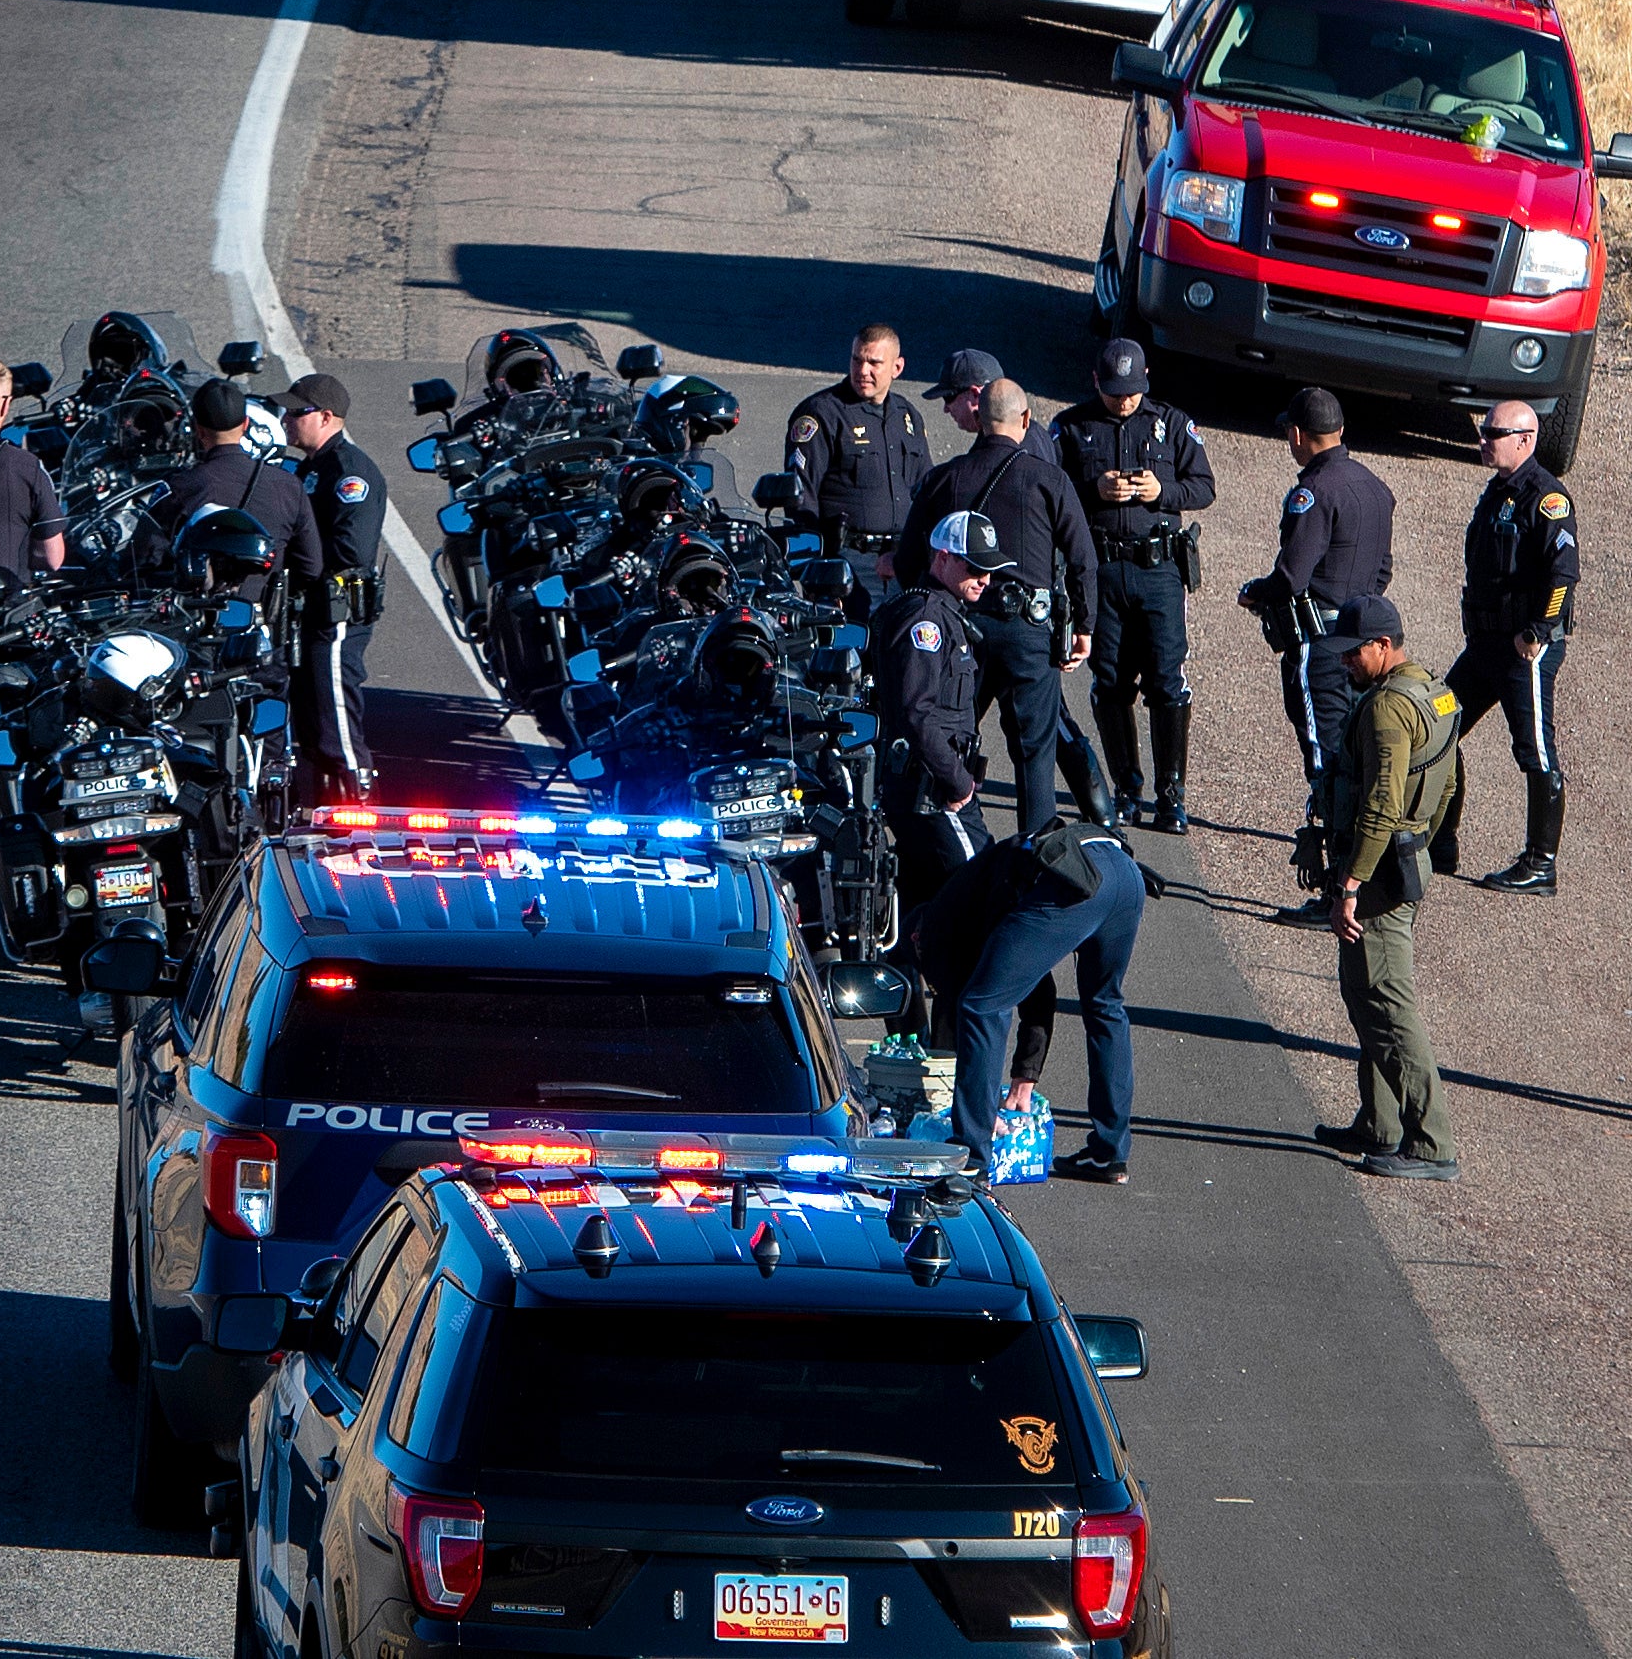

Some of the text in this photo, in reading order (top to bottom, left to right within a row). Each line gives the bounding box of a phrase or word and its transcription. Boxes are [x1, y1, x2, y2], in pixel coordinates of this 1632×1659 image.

[1367, 228, 1398, 246] Ford
[83, 776, 140, 795] POLICE
[717, 798, 777, 817] POLICE
[285, 1103, 490, 1137] POLICE
[764, 1501, 807, 1519] Ford
[1013, 1510, 1060, 1537] J720
[722, 1584, 841, 1616] 06551 G
[755, 1616, 808, 1627] Government
[749, 1627, 815, 1637] New Mexico USA
